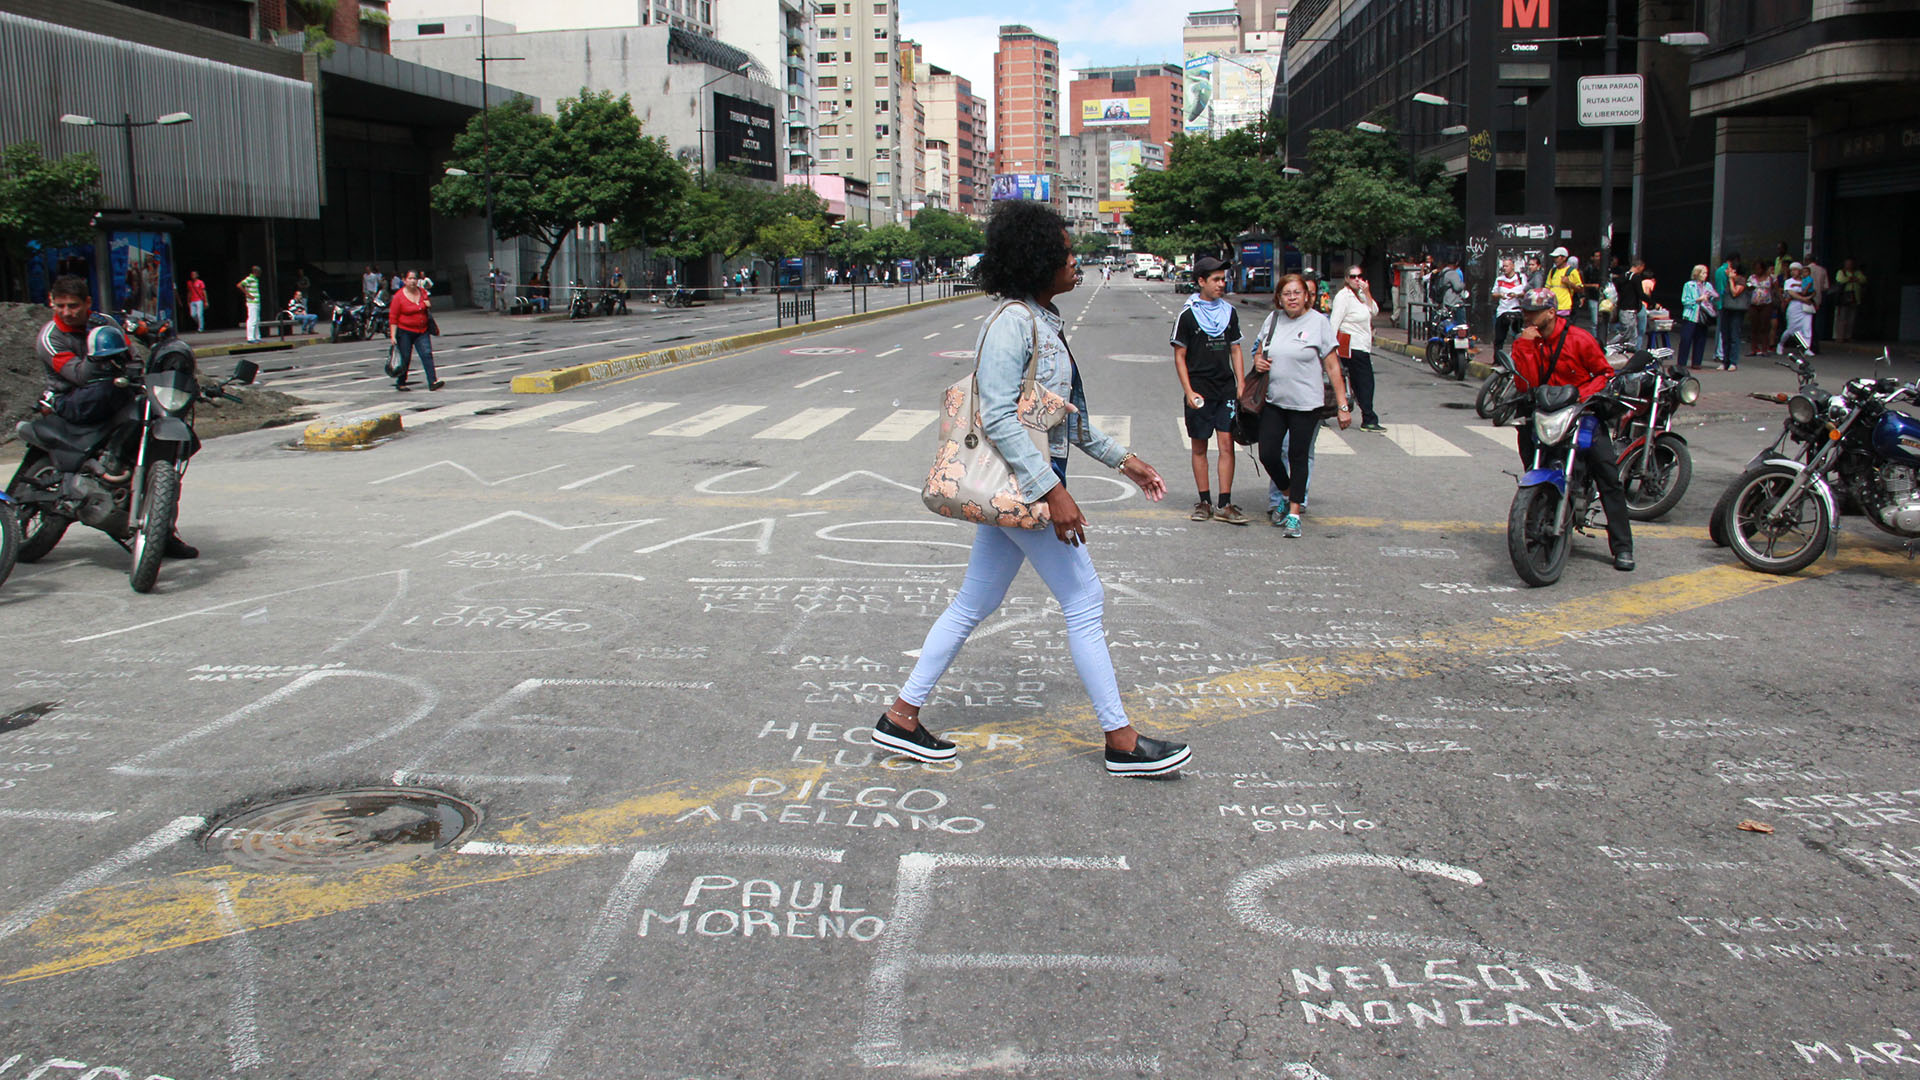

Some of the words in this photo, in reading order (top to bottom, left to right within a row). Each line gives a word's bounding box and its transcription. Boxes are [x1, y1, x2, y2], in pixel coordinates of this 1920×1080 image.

[1511, 43, 1539, 52] Chacao
[1609, 82, 1639, 90] PARADA
[1611, 96, 1634, 104] HACIA
[1595, 110, 1640, 118] LIBERTADOR
[402, 613, 593, 634] LORENZO
[443, 604, 584, 623] JOSE
[744, 777, 949, 814] DIEGO
[675, 802, 986, 835] ARELLANO
[1219, 803, 1363, 818] MIGUEL
[1251, 819, 1377, 833] BRAVO
[682, 874, 866, 914] PAUL
[636, 908, 886, 942] MORENO
[1291, 957, 1596, 996] NELSON
[1299, 998, 1673, 1033] MONCADA
